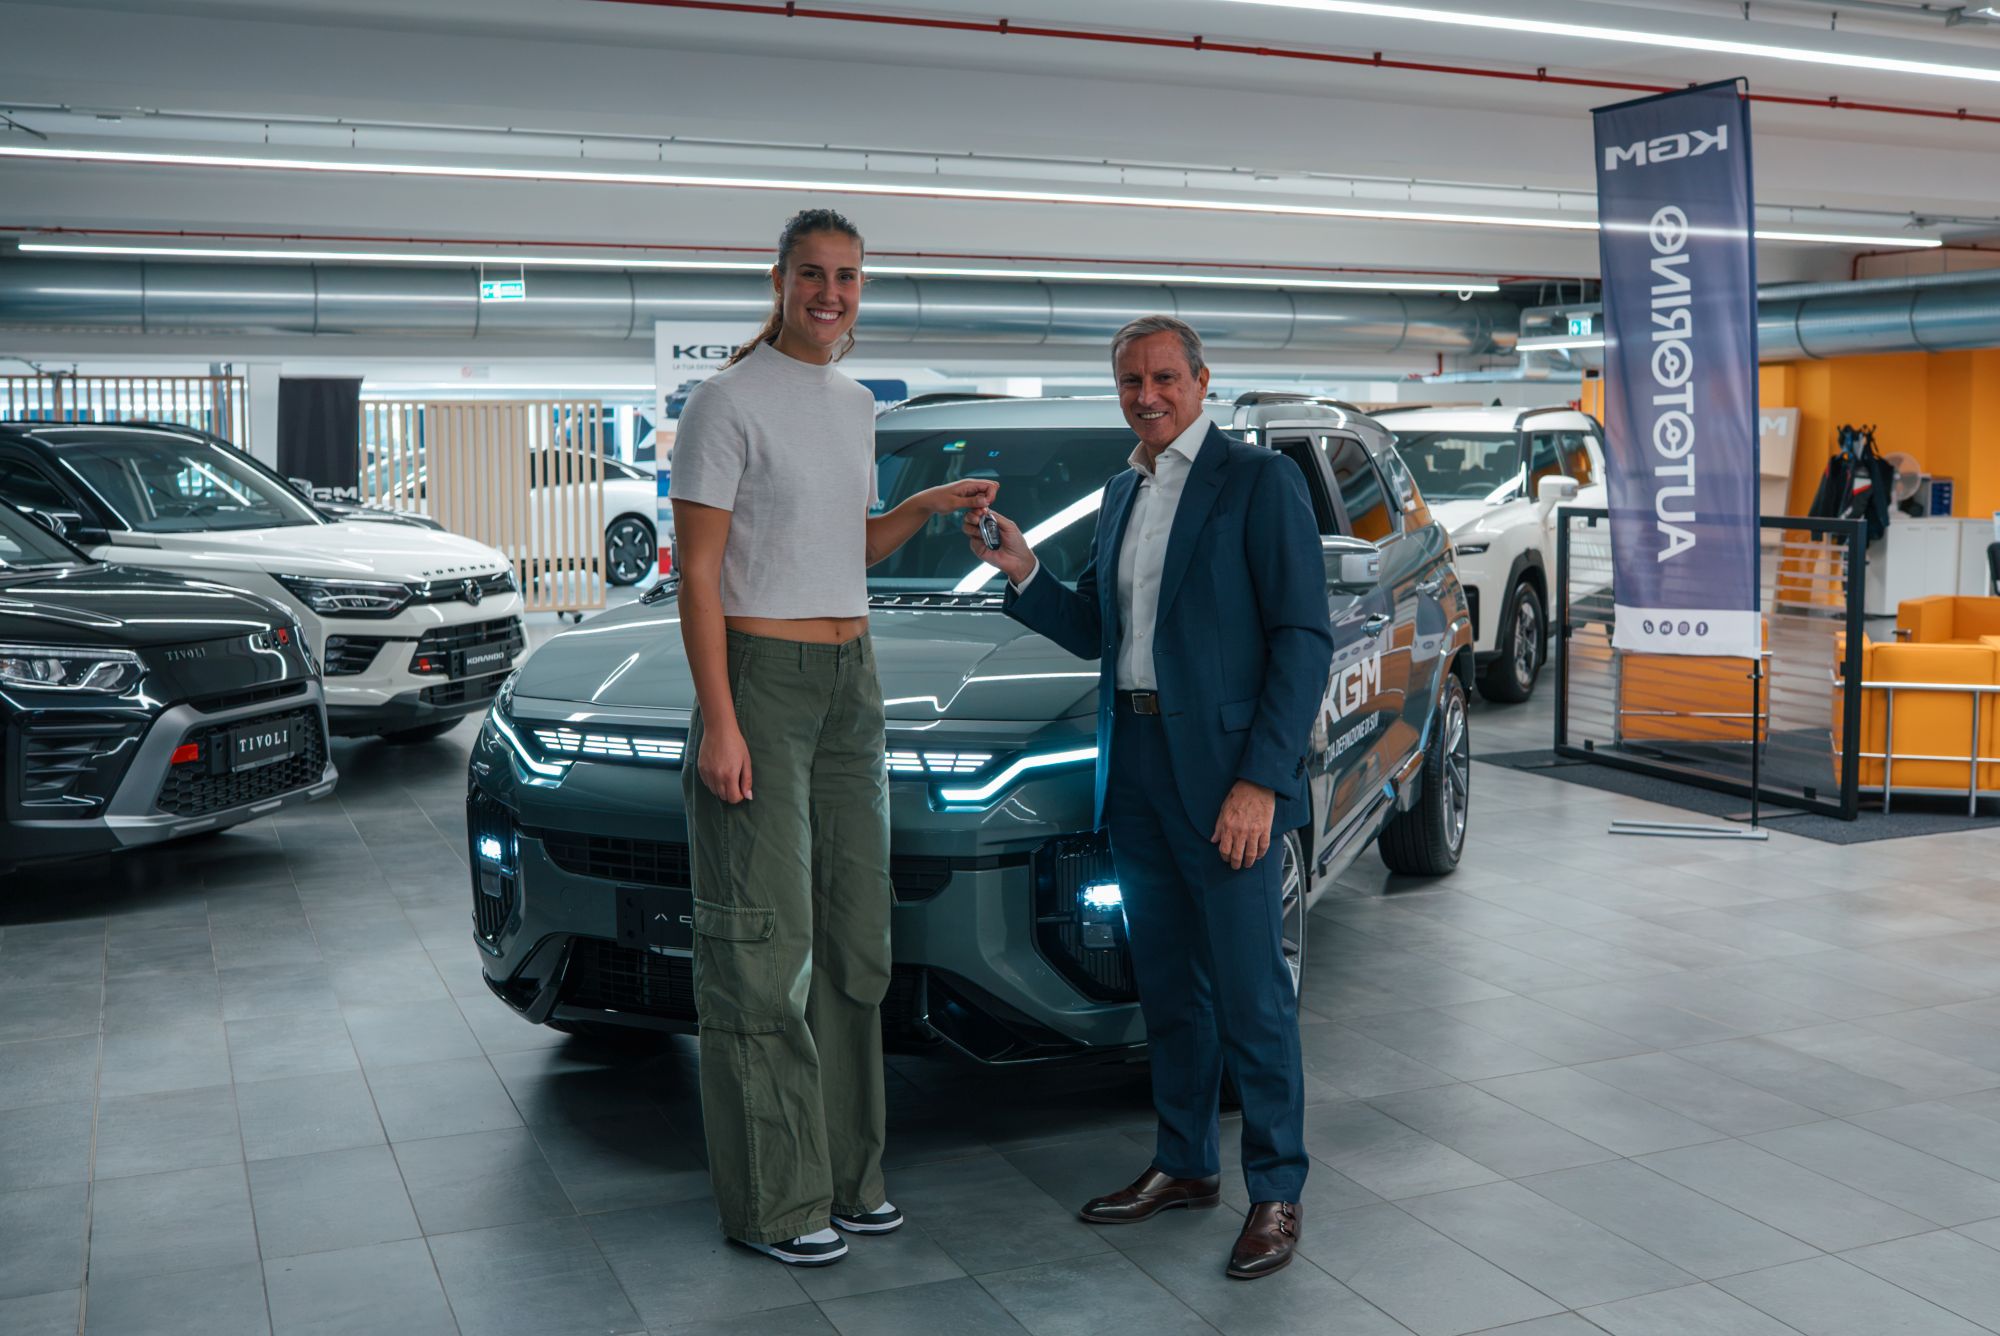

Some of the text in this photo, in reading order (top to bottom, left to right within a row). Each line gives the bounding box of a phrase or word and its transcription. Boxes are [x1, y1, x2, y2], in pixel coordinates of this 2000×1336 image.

[311, 486, 357, 502] GM
[165, 647, 206, 661] TIVOLI
[466, 651, 505, 665] KORANDO
[1320, 650, 1381, 734] KGM
[239, 730, 288, 753] TIVOLI
